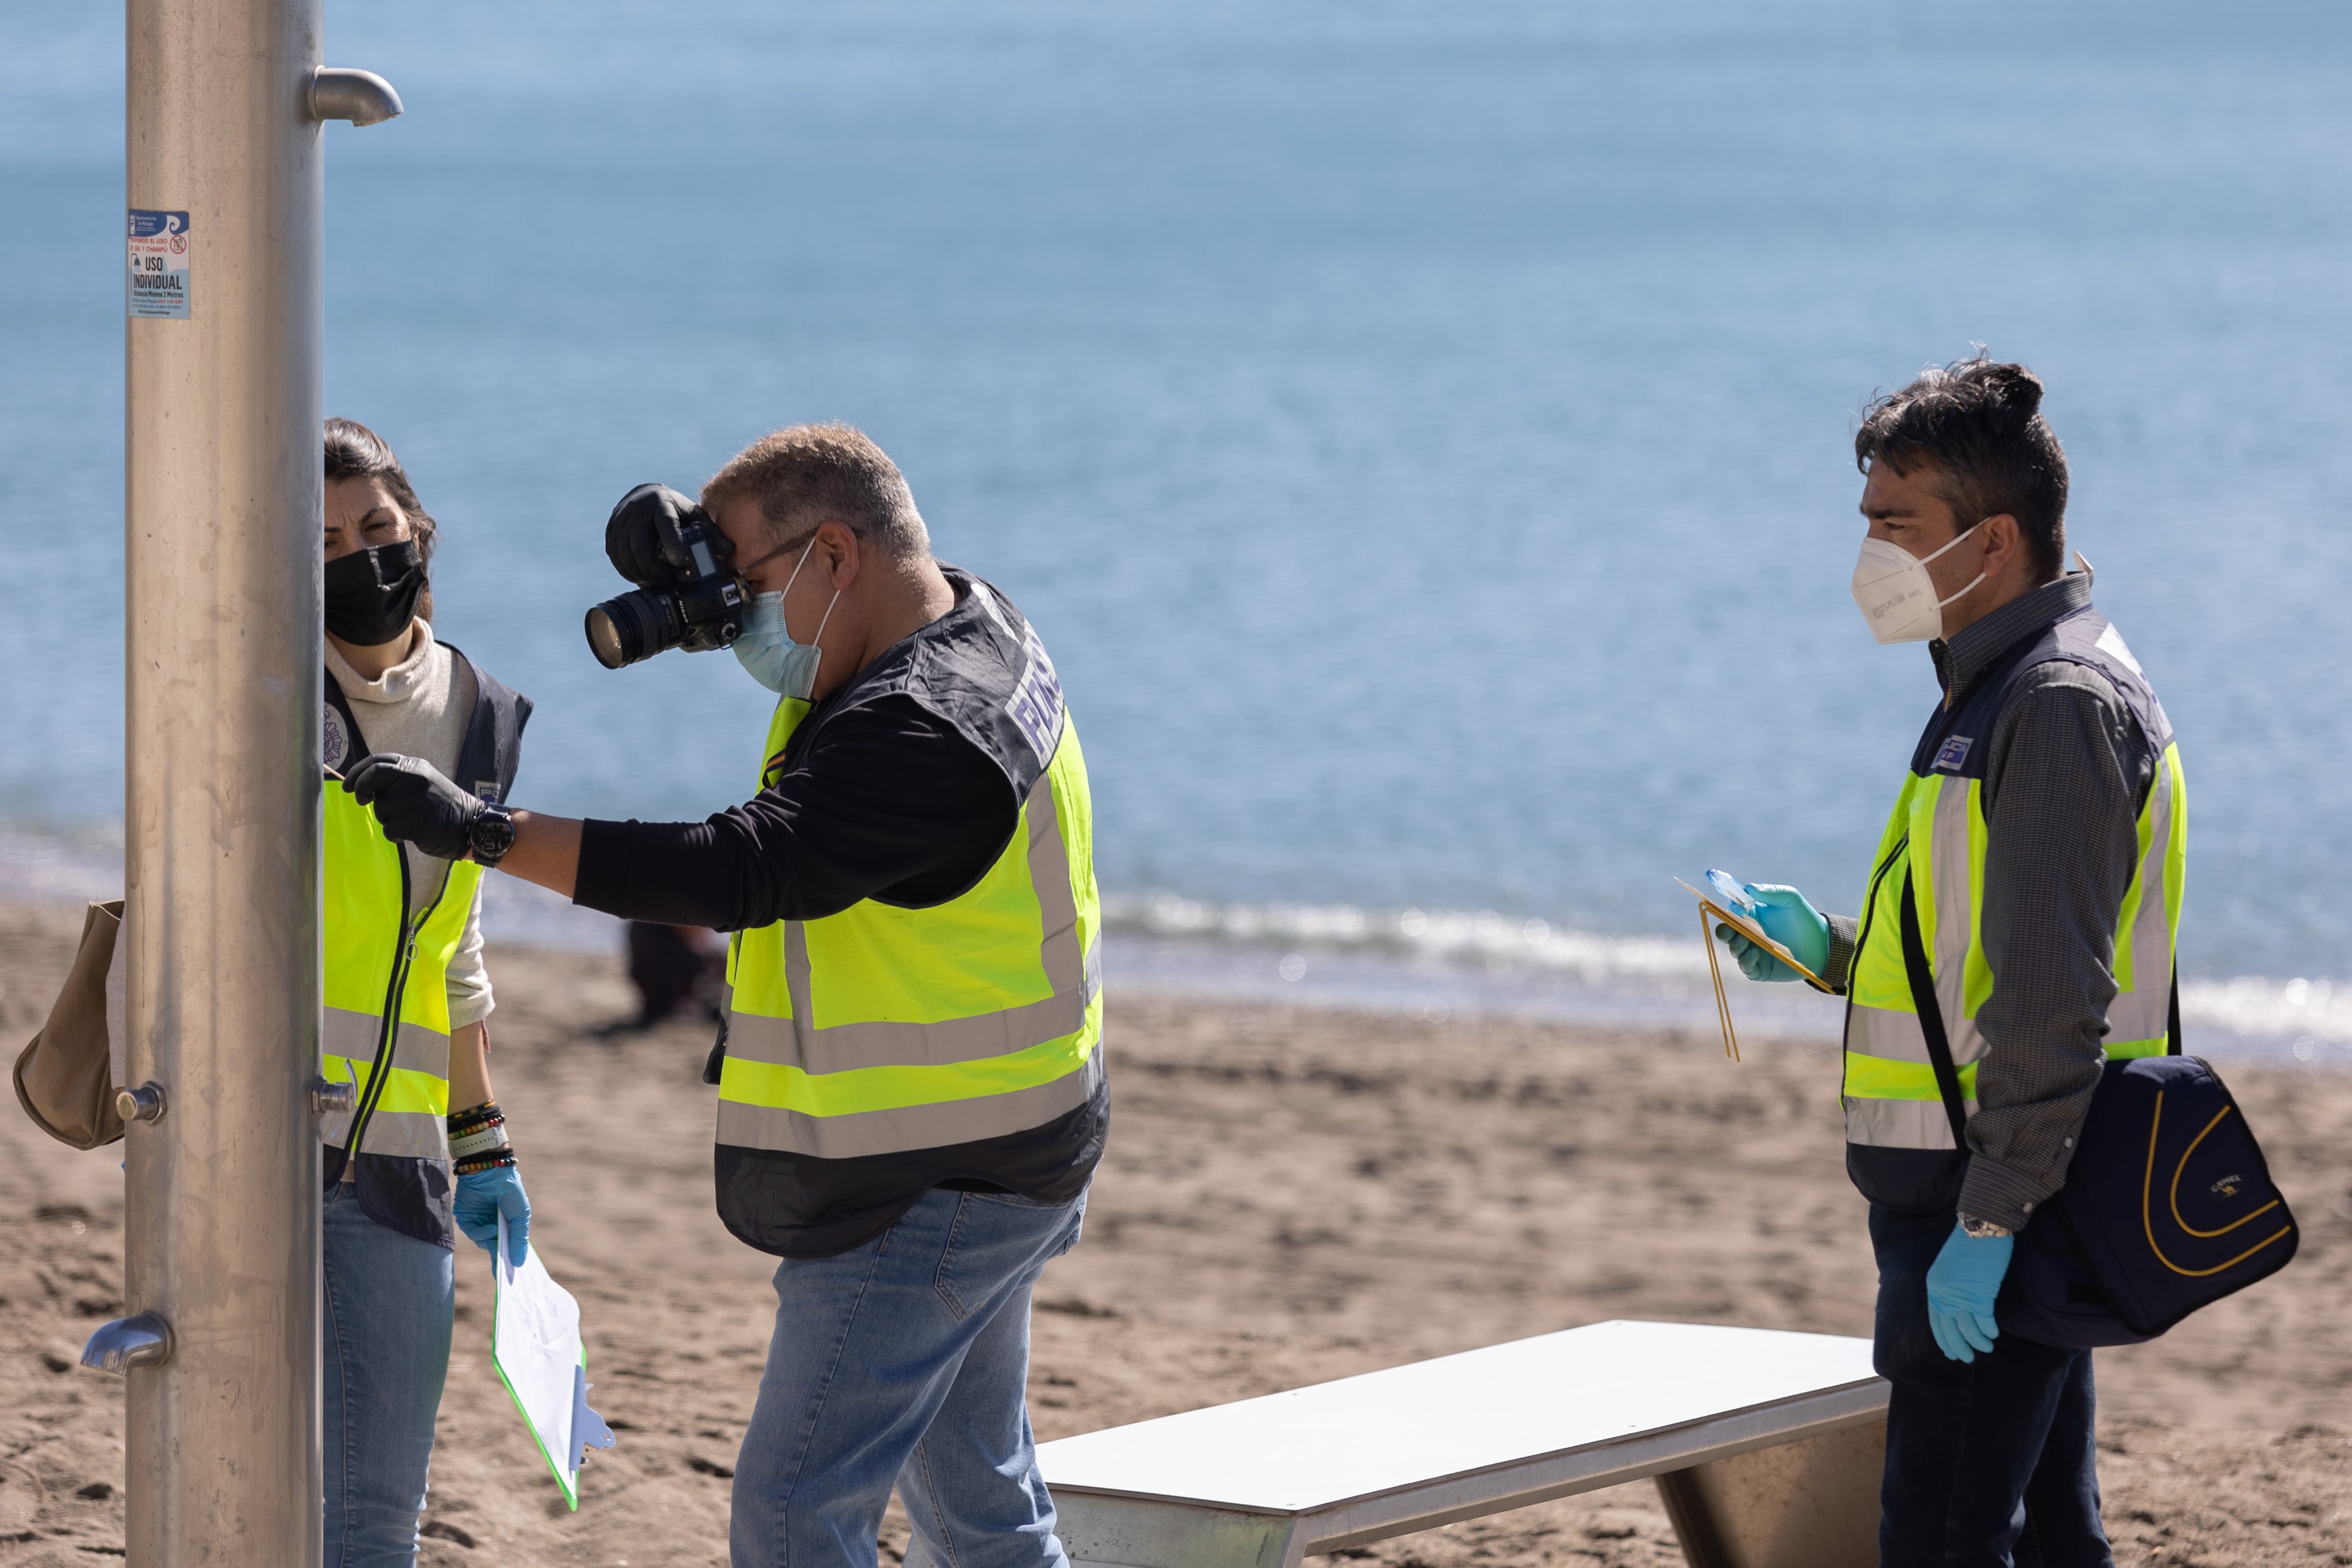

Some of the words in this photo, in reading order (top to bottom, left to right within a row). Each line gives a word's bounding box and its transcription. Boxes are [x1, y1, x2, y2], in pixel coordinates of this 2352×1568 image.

[146, 244, 167, 253] CHAMPÚ
[145, 256, 163, 272] USO
[133, 274, 183, 290] INDIVIDUAL
[678, 600, 689, 623] Nikon
[2210, 1174, 2242, 1193] CAMEL
